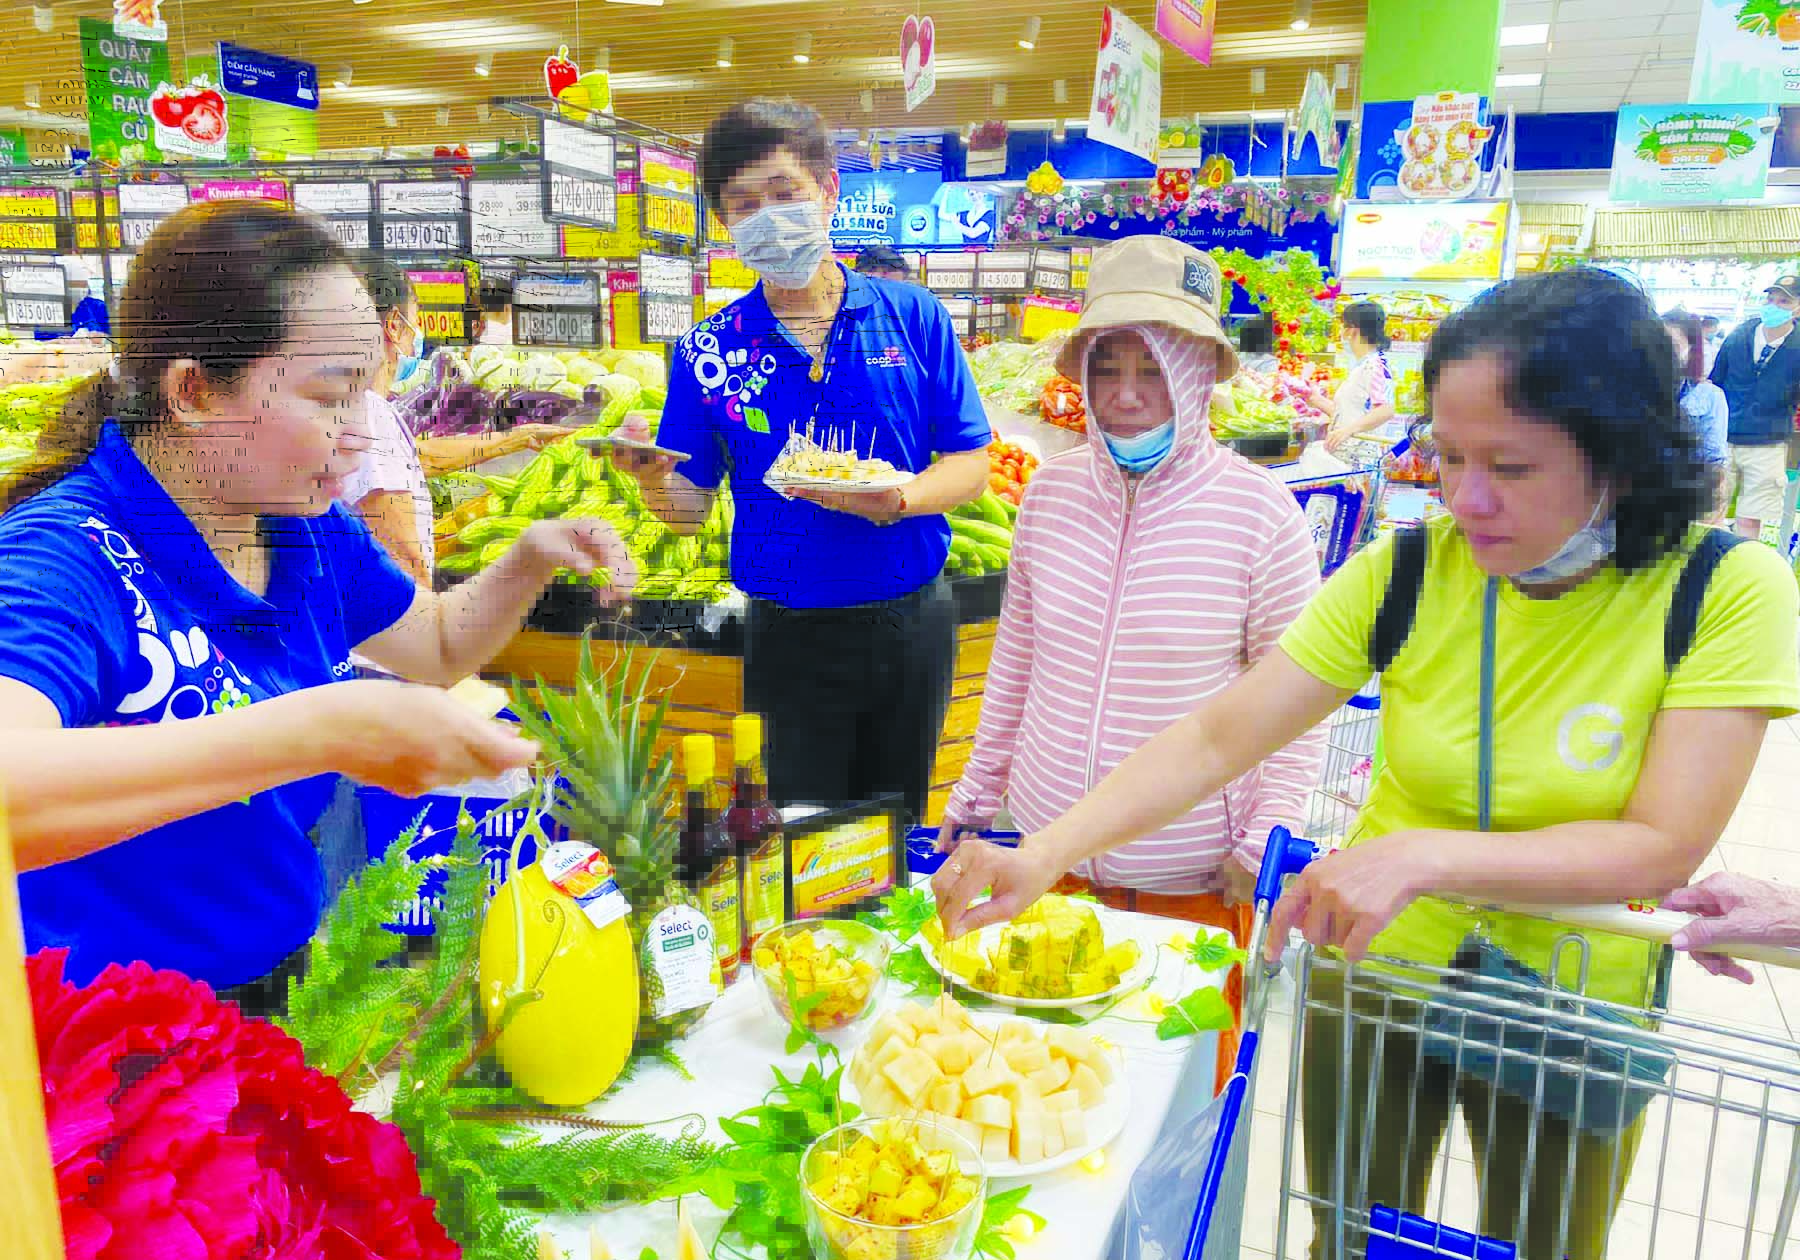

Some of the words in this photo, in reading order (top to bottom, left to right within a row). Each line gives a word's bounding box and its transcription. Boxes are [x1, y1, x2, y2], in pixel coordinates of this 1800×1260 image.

[109, 65, 150, 90] CÂN
[121, 118, 149, 141] CỦ
[1557, 702, 1624, 772] G
[554, 850, 585, 872] Select
[660, 920, 693, 937] Select
